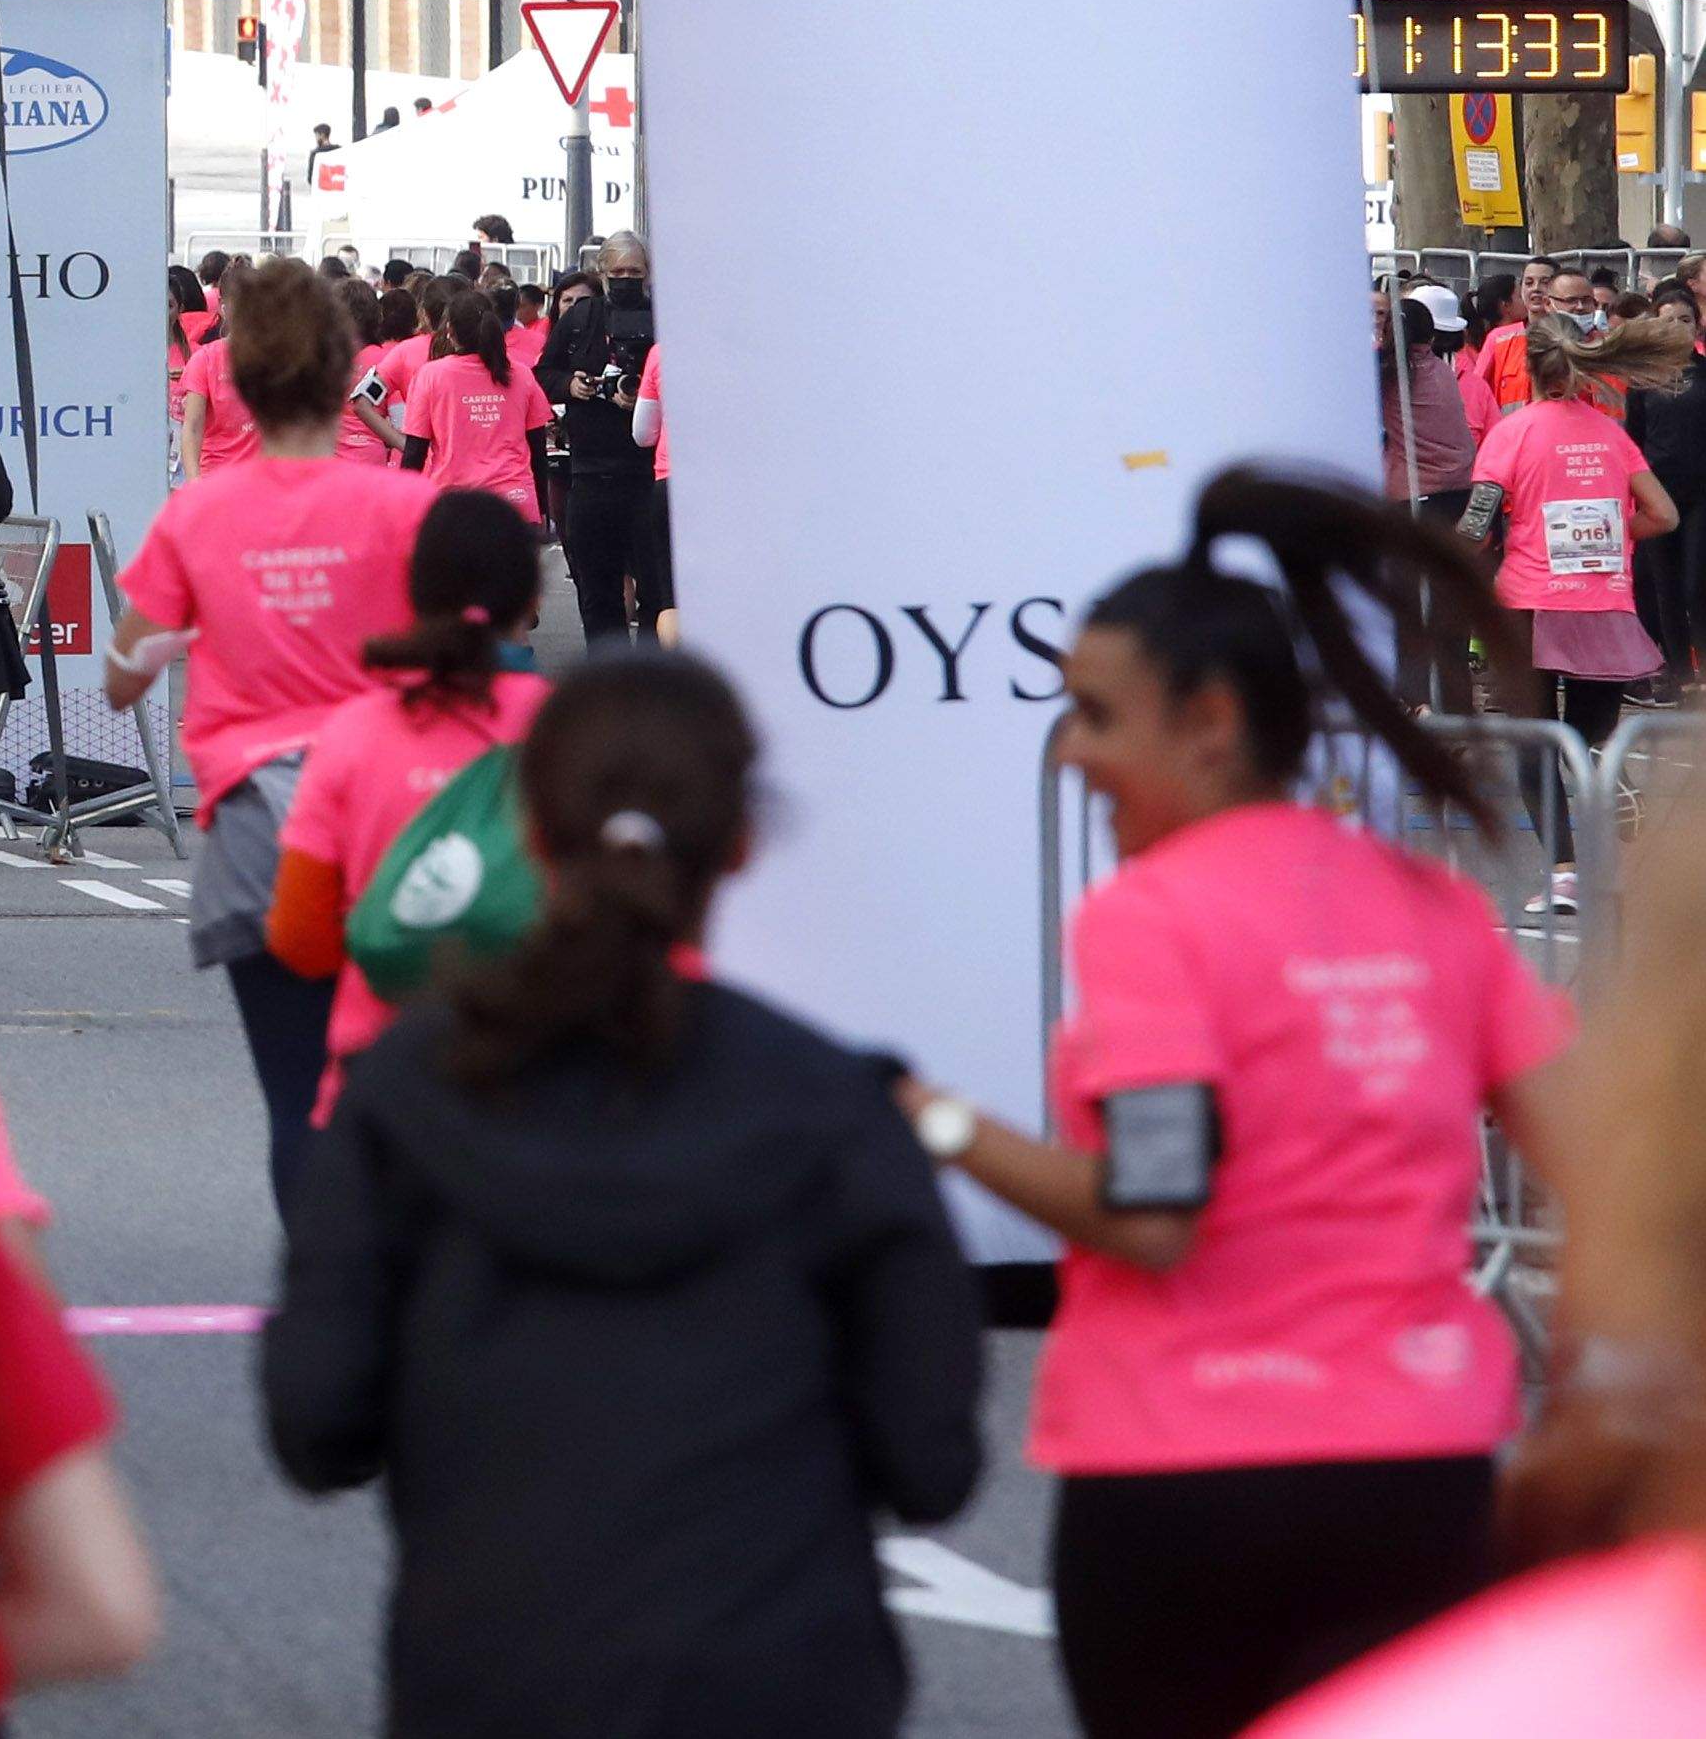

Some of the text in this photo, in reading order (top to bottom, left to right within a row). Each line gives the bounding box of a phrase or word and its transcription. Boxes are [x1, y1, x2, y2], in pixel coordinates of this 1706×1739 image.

[522, 177, 565, 201] PUN
[462, 395, 506, 404] CARRERA
[471, 404, 498, 413] DE LA
[469, 412, 501, 422] MUJER
[1556, 443, 1609, 455] CARRERA
[1567, 457, 1601, 466] DE LA
[1566, 467, 1604, 477] MUJER
[798, 597, 1065, 709] OYS
